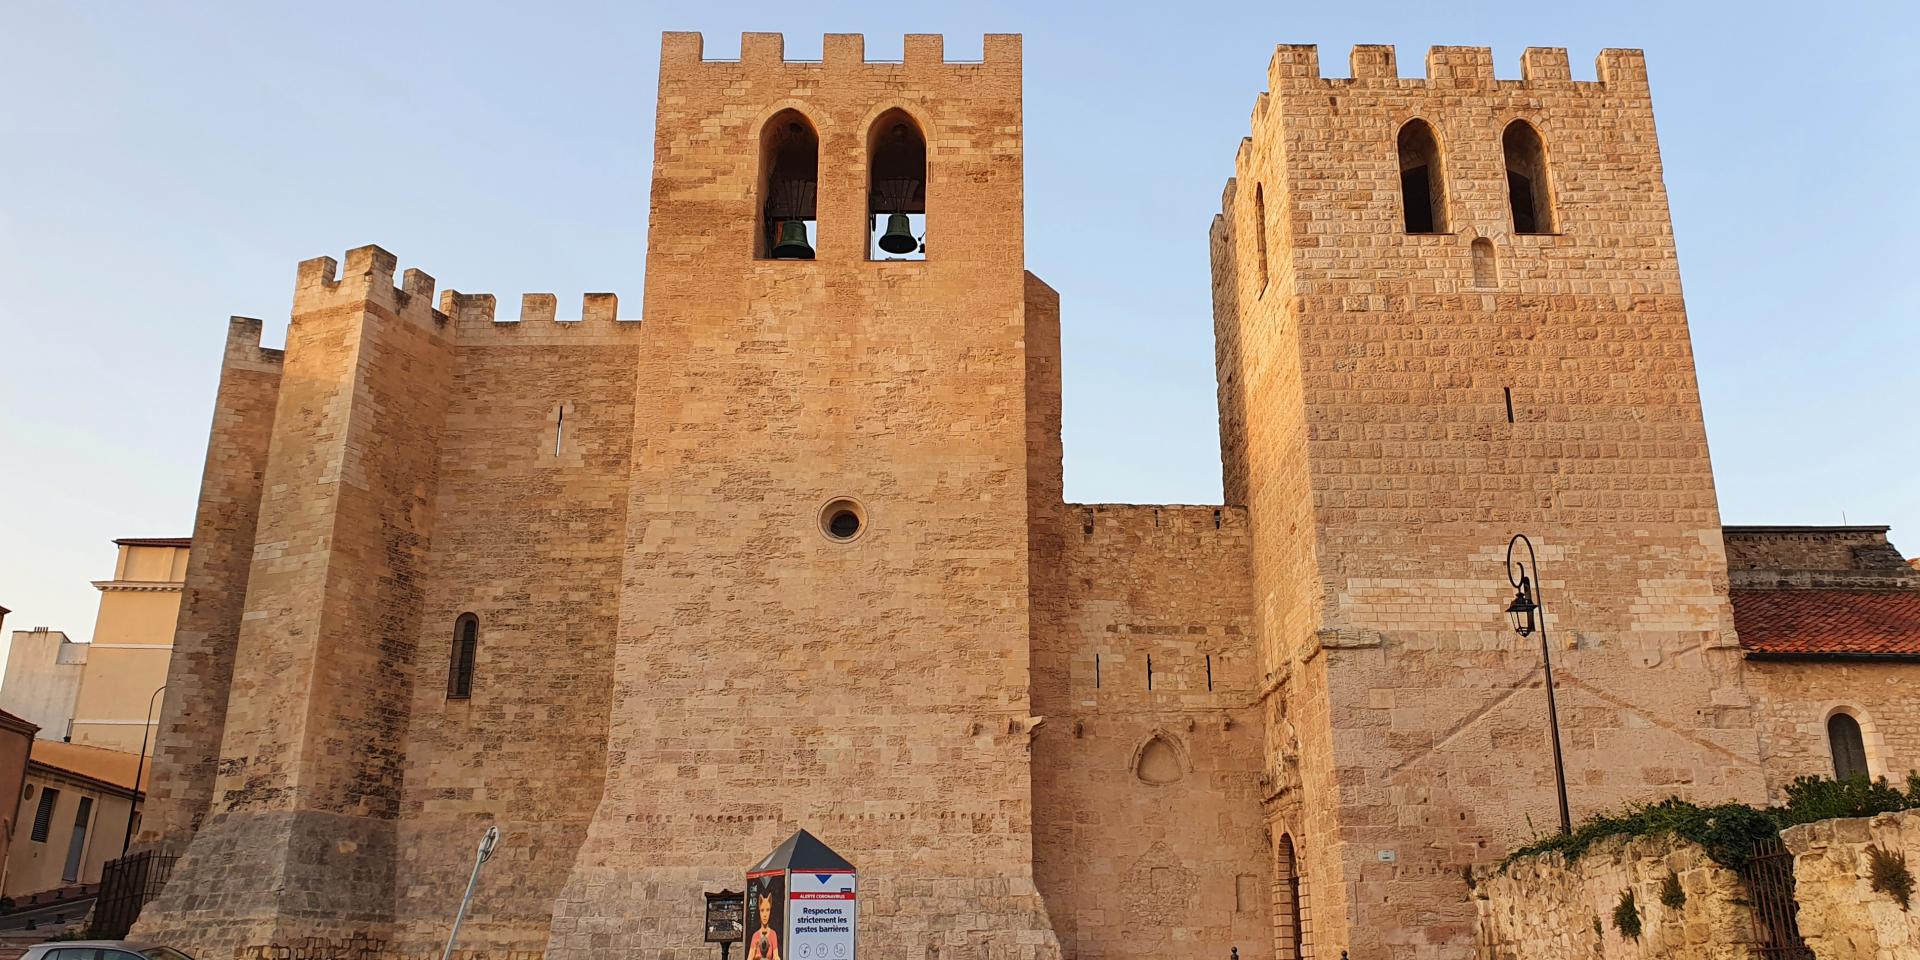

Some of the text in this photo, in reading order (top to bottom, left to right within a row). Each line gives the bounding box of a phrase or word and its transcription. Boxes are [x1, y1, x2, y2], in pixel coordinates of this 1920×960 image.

[803, 907, 842, 915] Respectons
[797, 916, 847, 924] strictement les
[795, 925, 849, 934] gestes barrières
